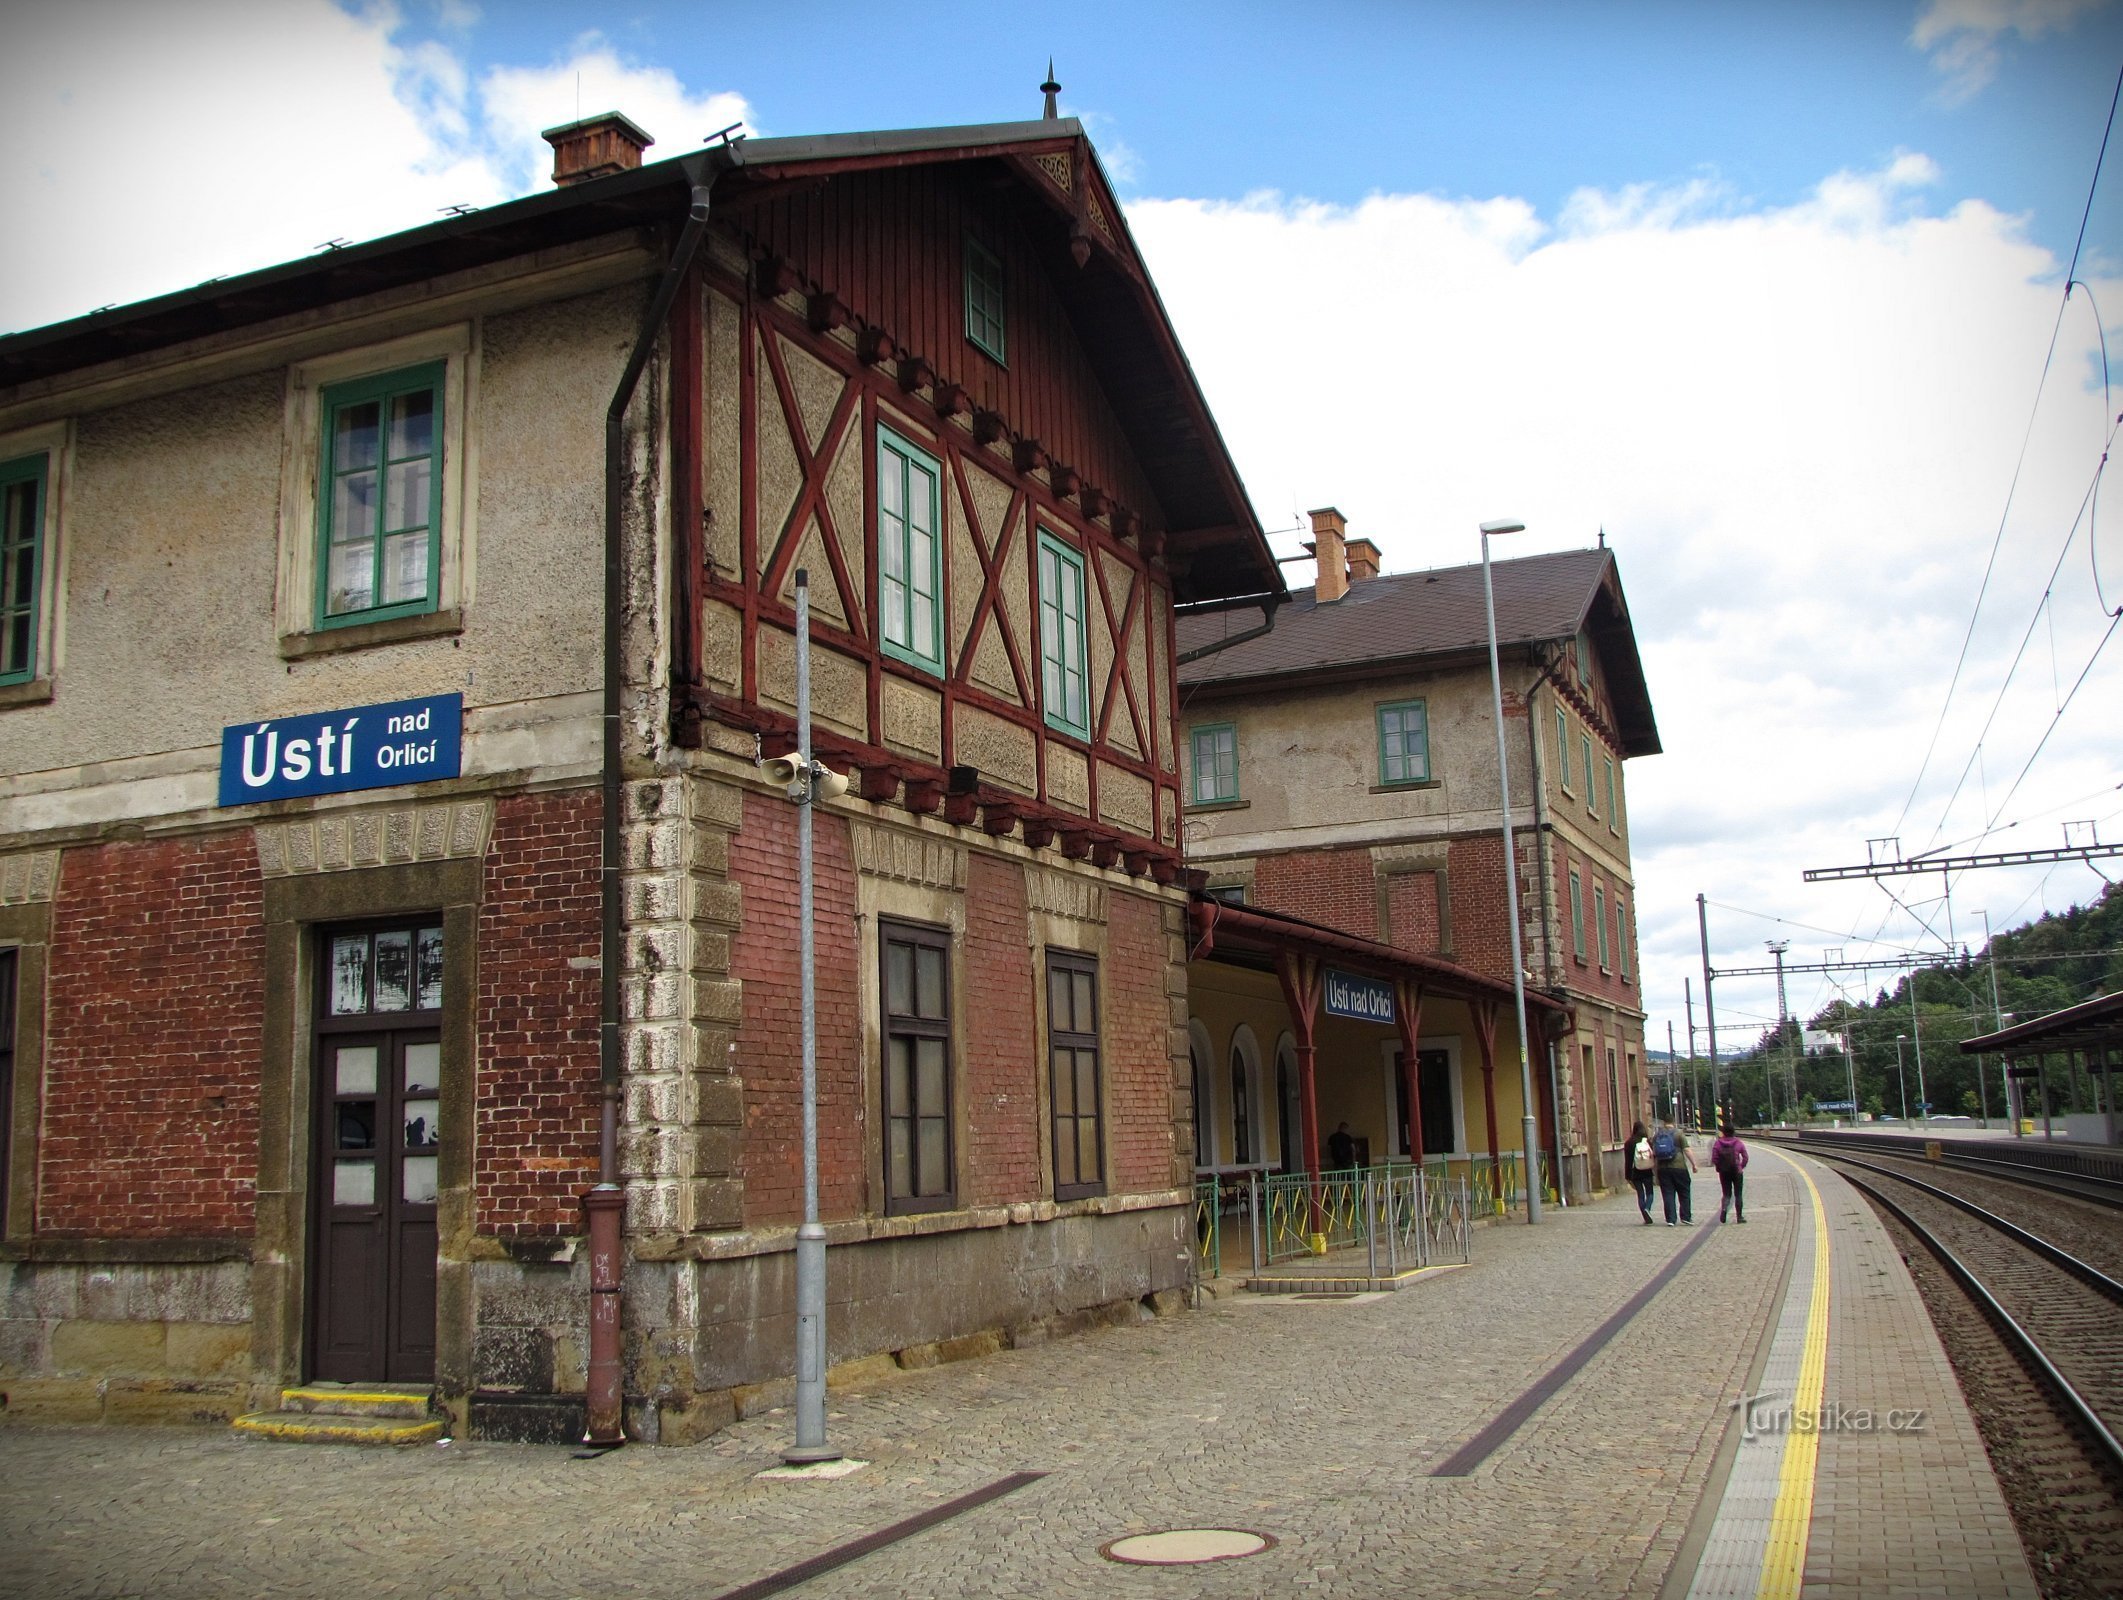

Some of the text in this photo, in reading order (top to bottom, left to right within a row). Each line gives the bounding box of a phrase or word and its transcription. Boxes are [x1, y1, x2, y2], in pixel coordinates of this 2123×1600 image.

[388, 708, 430, 734] nad
[242, 717, 360, 787] Ústí
[377, 740, 438, 769] Orlicí
[1329, 972, 1391, 1017] Ústí nad Orlicí
